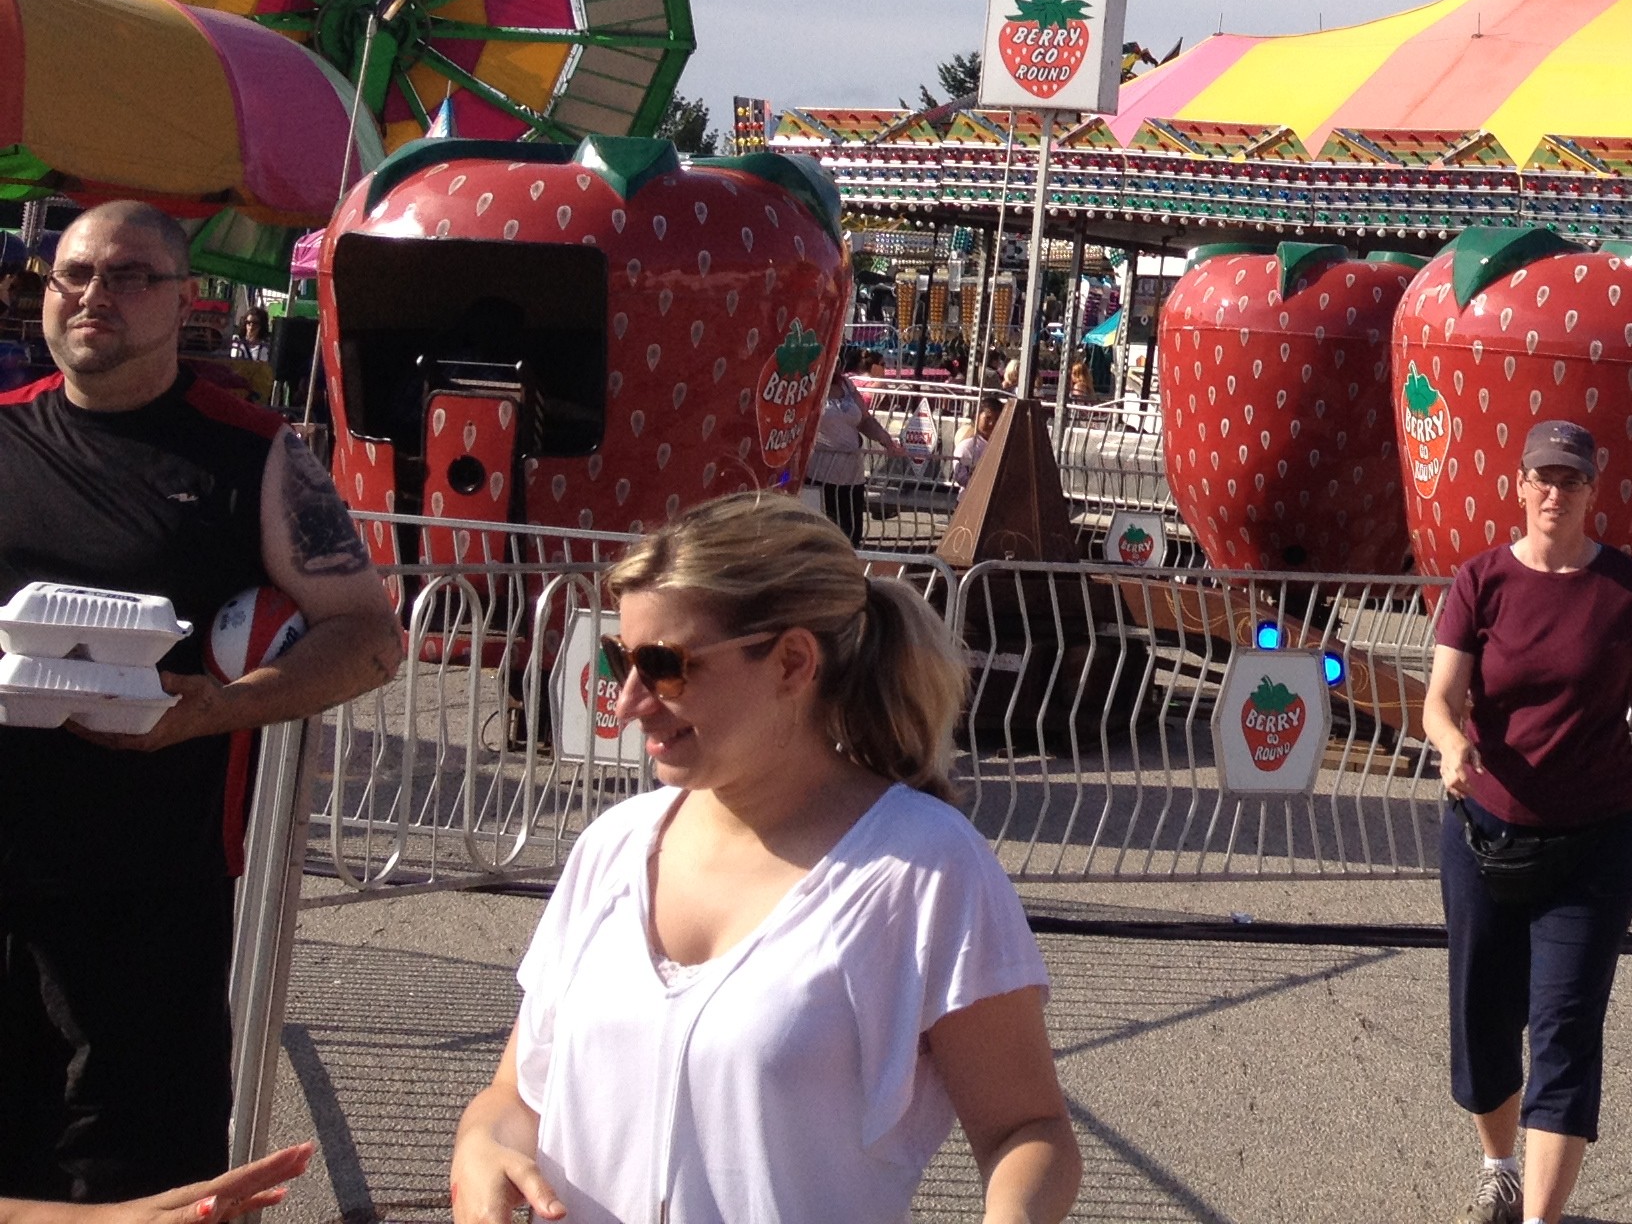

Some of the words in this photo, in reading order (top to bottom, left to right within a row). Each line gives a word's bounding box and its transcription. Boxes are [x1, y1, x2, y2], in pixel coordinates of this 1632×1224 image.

[1012, 26, 1080, 46] BERRY
[1031, 46, 1058, 63] GO
[1015, 64, 1070, 82] ROUND
[762, 371, 816, 405] BERRY
[1405, 407, 1444, 442] BERRY
[1418, 444, 1430, 459] GO
[1414, 457, 1439, 482] ROUND
[1120, 540, 1151, 552] BERRY
[1245, 707, 1301, 732] BERRY
[1266, 733, 1279, 745] GO
[1254, 742, 1291, 761] ROUND
